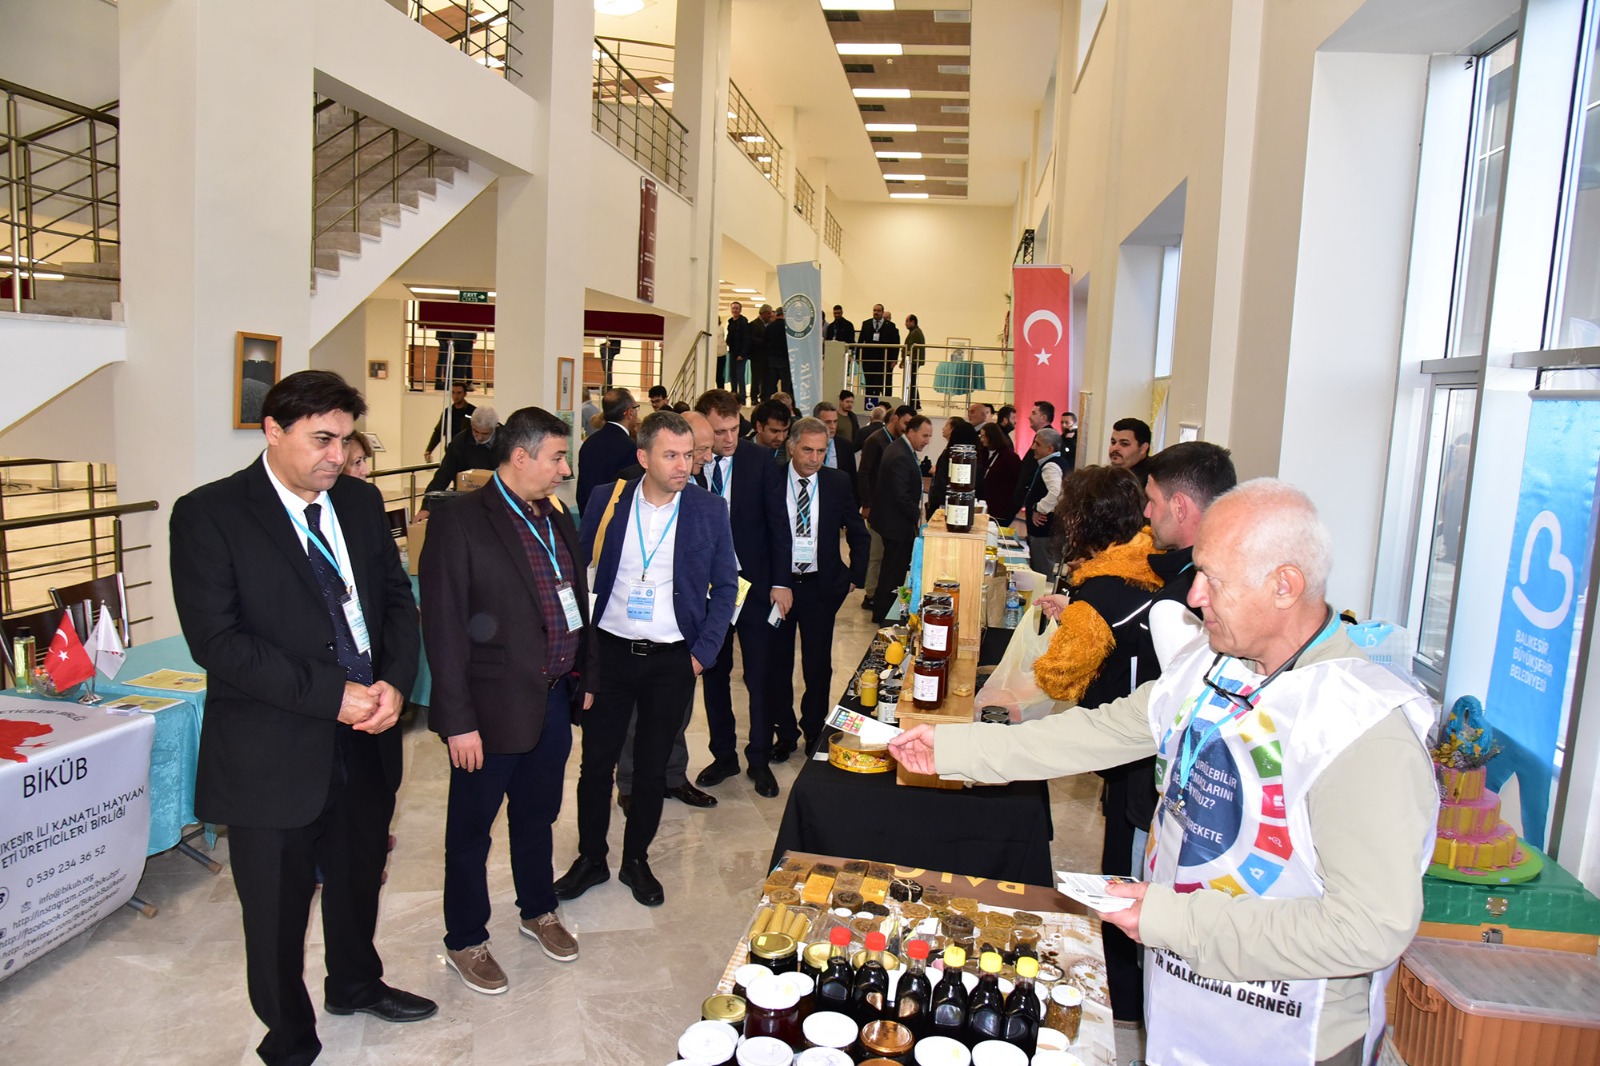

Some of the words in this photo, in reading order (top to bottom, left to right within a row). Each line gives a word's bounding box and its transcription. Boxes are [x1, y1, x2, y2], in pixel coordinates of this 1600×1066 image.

[1513, 646, 1553, 677] BÜYÜKŞEHİR
[1515, 629, 1549, 655] BALIKESİR
[1510, 664, 1547, 693] BELEDİYESİ
[23, 757, 88, 799] BİKÜB
[20, 822, 88, 859] ÜRETİCİLERİ
[91, 805, 126, 830] BİRLİĞİ
[37, 822, 49, 838] İLİ
[52, 805, 101, 832] KANATLI
[103, 786, 145, 810] HAYVAN
[26, 877, 34, 888] 0
[37, 868, 55, 883] 539
[58, 858, 76, 874] 234
[79, 852, 92, 865] 36
[94, 844, 106, 857] 52
[1166, 961, 1232, 998] KALKINMA
[1236, 988, 1303, 1019] DERNEĞİ
